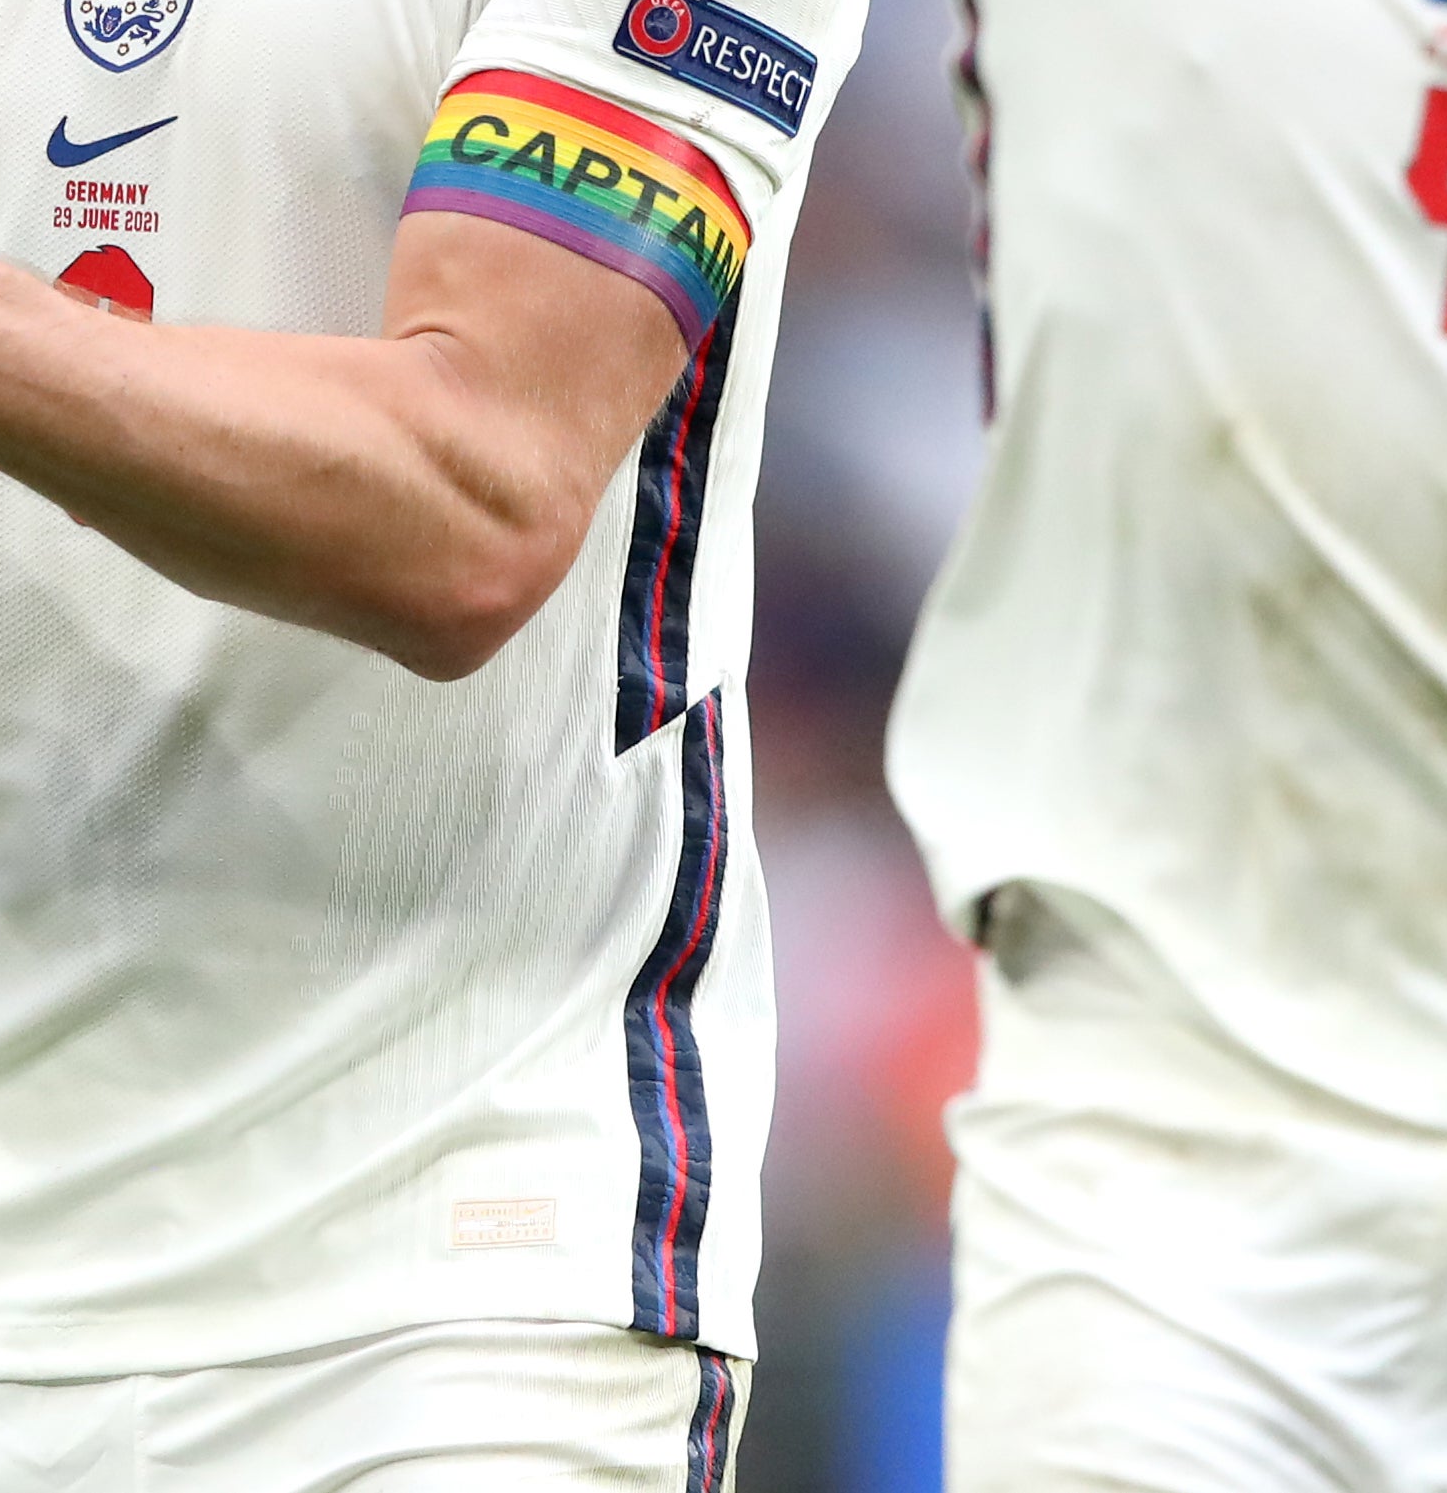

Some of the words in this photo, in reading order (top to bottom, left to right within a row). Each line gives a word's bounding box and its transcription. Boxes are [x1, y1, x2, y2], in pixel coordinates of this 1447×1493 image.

[691, 25, 812, 112] RESPECT
[65, 180, 149, 205] GERMANY
[53, 206, 72, 228] 29
[77, 208, 120, 231] JUNE
[124, 210, 160, 233] 2021
